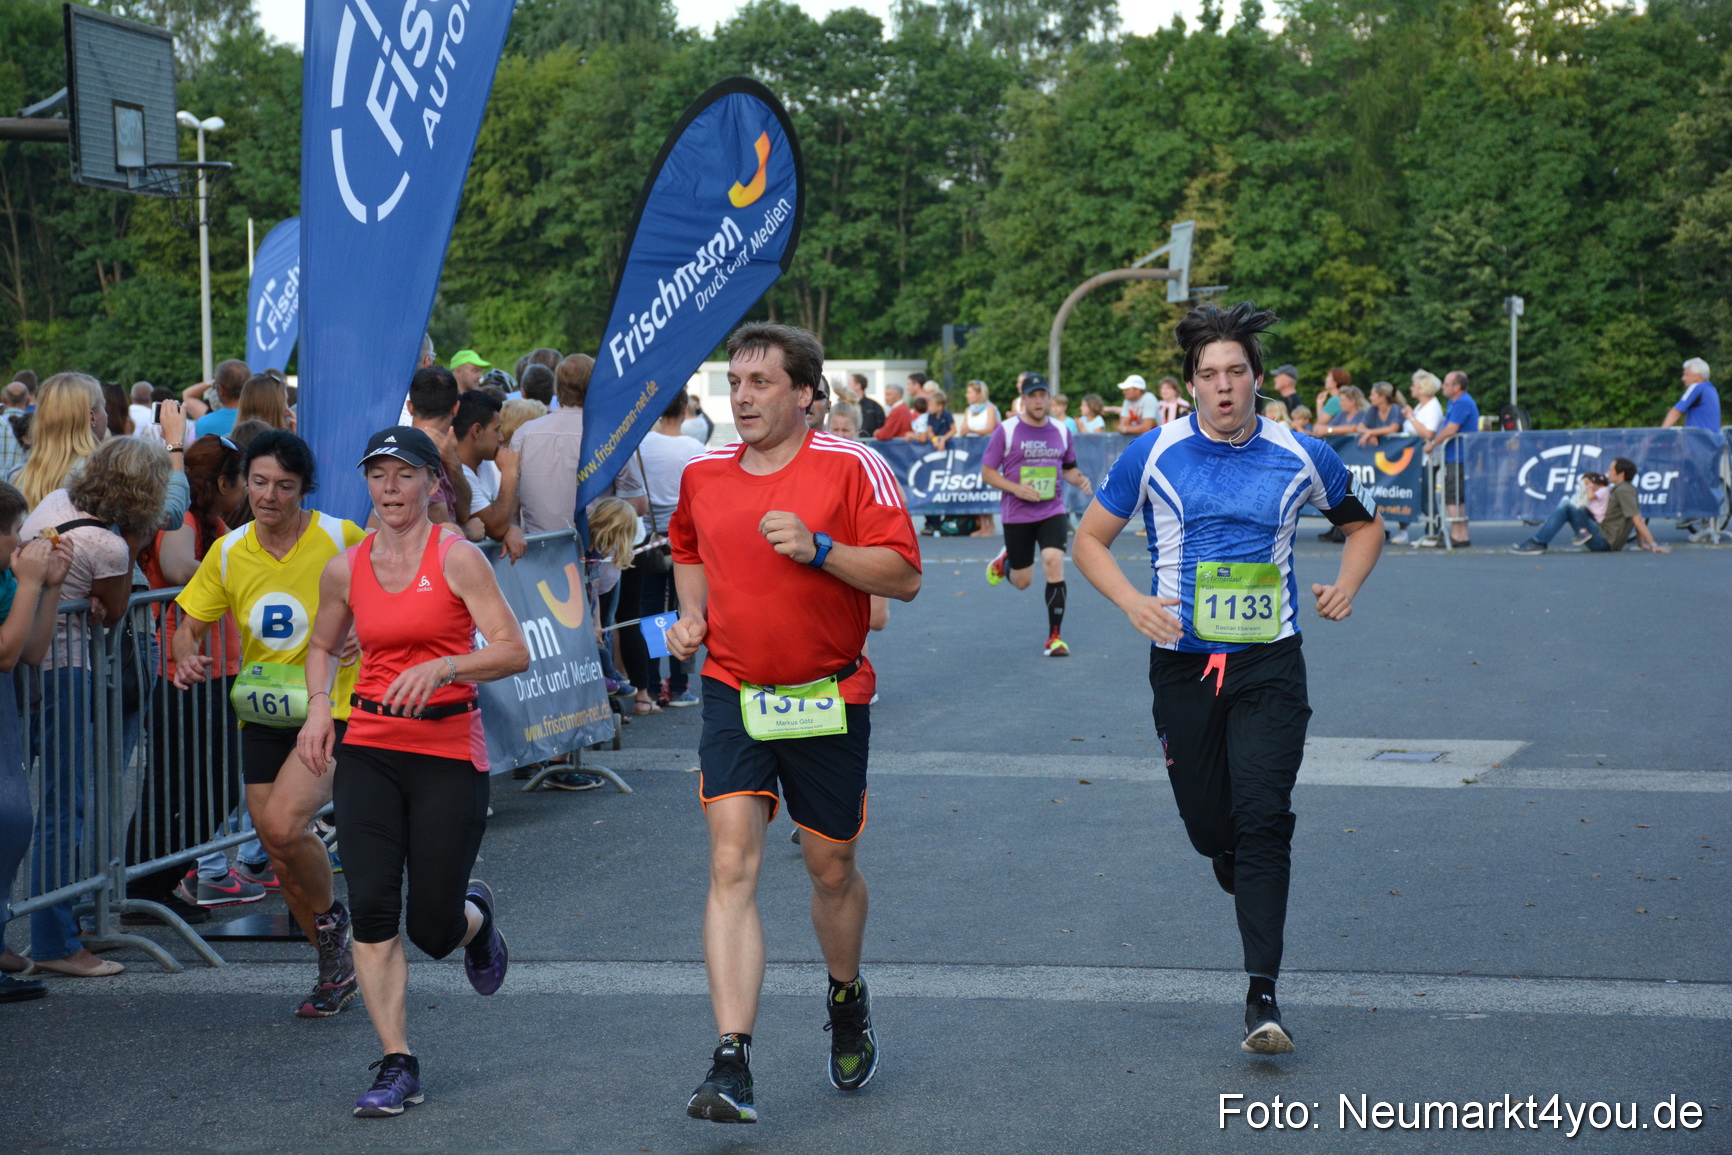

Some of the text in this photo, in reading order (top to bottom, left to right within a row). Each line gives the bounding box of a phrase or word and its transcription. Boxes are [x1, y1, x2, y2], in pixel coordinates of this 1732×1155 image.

[366, 0, 440, 157] Fis
[694, 267, 729, 312] Druck
[749, 197, 792, 255] Medien
[608, 215, 744, 378] Frischmann
[1020, 440, 1047, 450] HECK
[1023, 448, 1062, 458] DESIGN
[262, 604, 294, 638] B
[1205, 594, 1273, 620] 1133
[545, 662, 570, 692] und
[247, 691, 291, 717] 161
